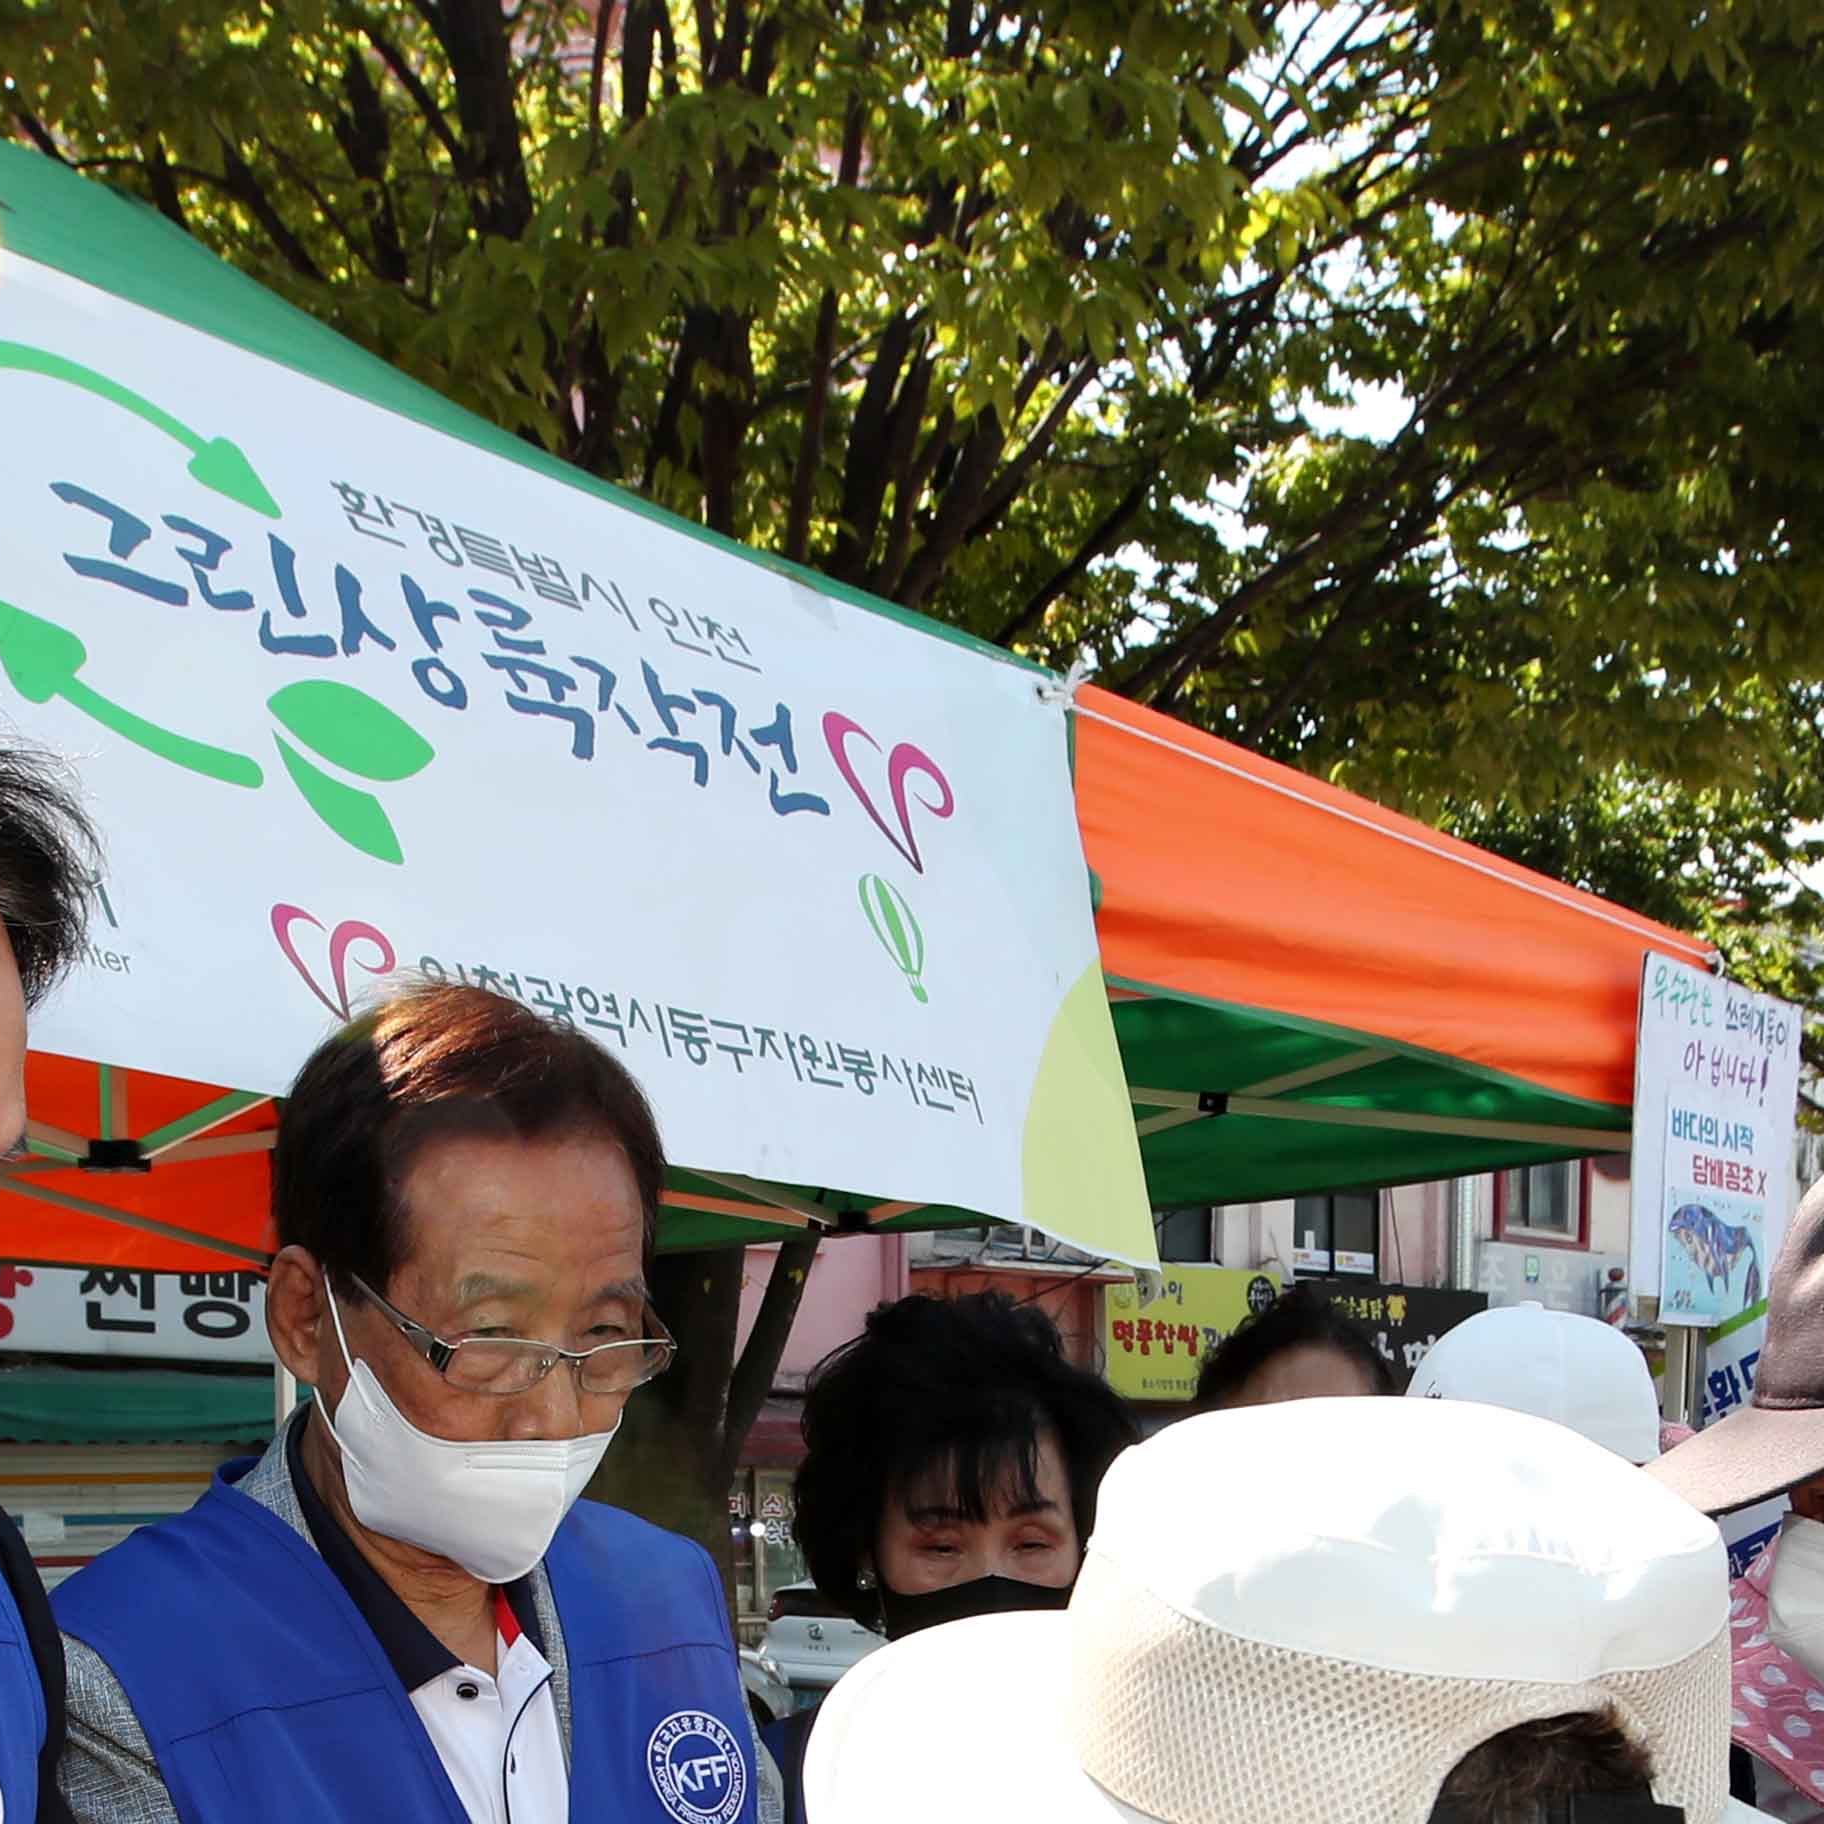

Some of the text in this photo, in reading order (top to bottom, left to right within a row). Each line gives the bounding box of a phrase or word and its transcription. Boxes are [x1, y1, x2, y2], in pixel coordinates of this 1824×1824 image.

[330, 480, 763, 674] 환경특별시 인천
[1671, 1107, 1755, 1156] 바다의 시작
[1692, 1154, 1754, 1196] 담배꽁초
[670, 1754, 727, 1794] KFF
